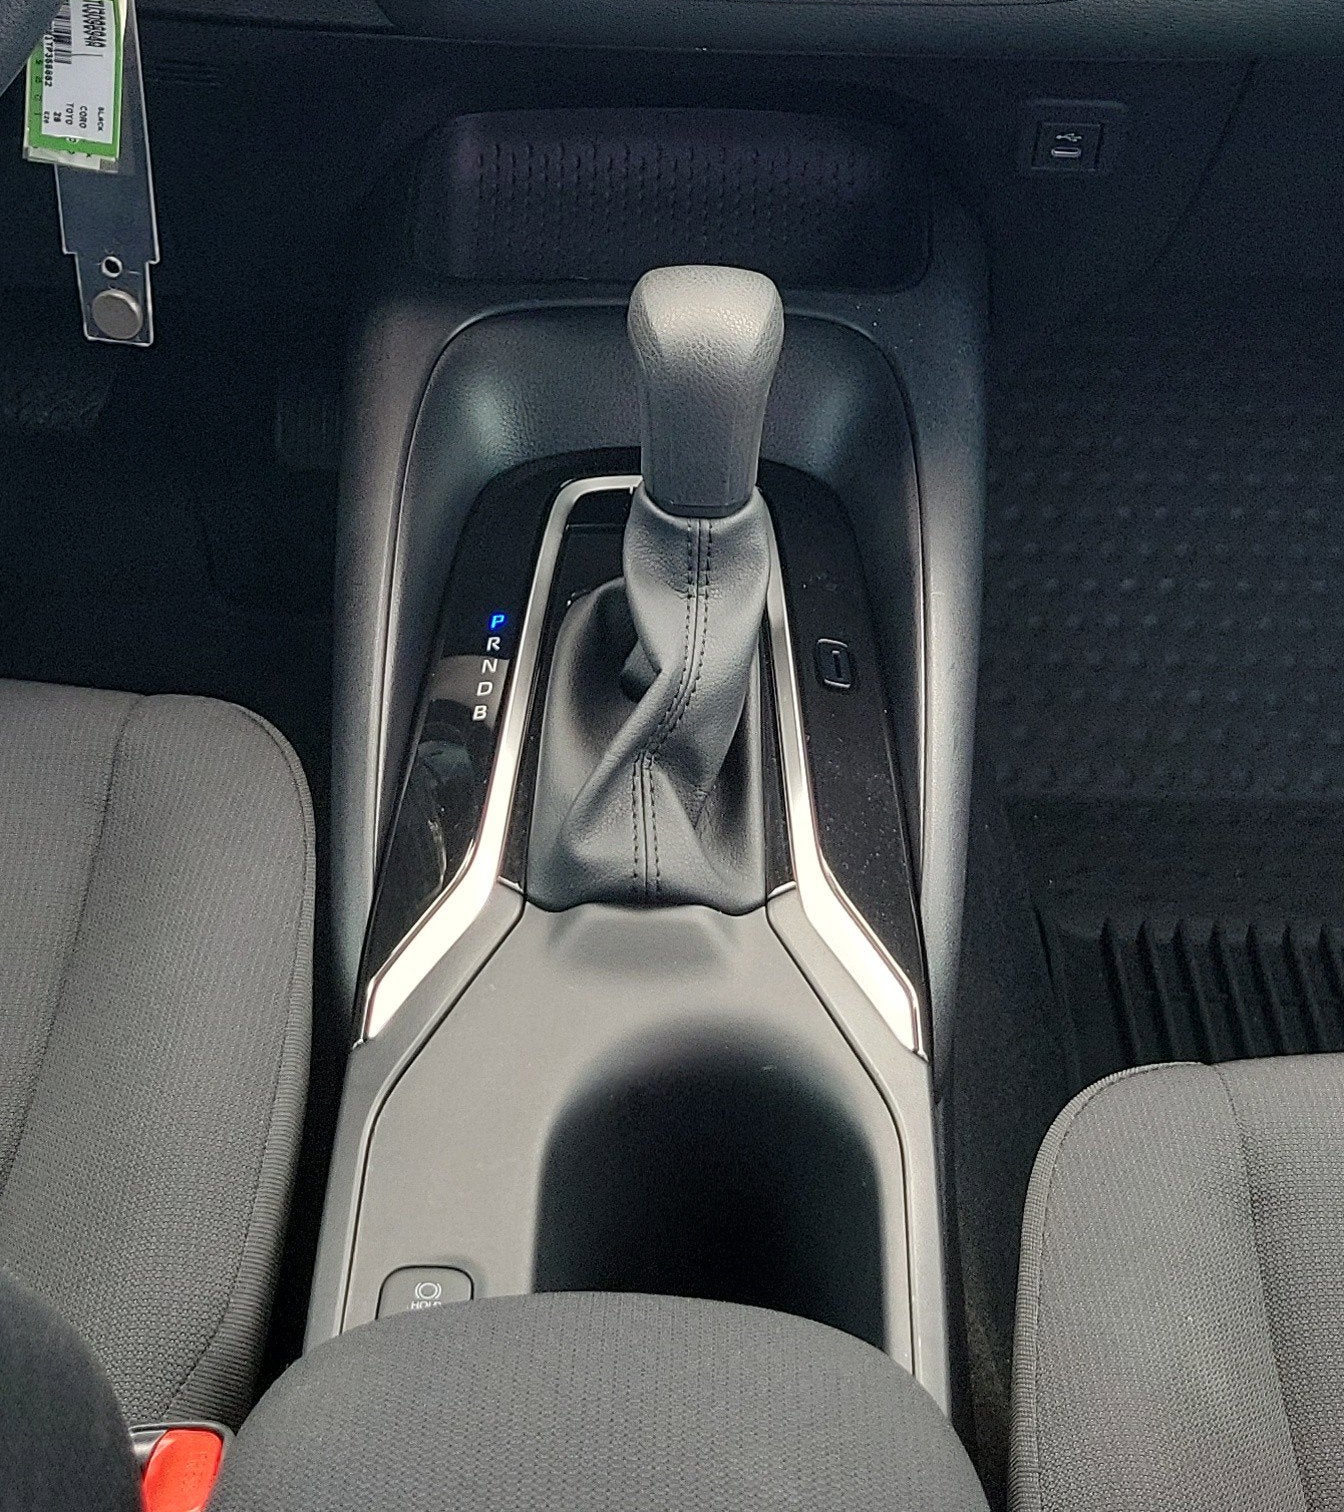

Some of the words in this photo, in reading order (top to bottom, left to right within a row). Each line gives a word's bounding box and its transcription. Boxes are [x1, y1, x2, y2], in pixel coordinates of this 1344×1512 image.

[65, 102, 75, 126] TOYO
[79, 105, 88, 129] CORO
[97, 106, 105, 132] BLACK
[490, 614, 505, 629] P
[486, 636, 501, 652] R
[481, 658, 498, 674] N
[476, 681, 493, 697] D
[472, 705, 488, 722] B
